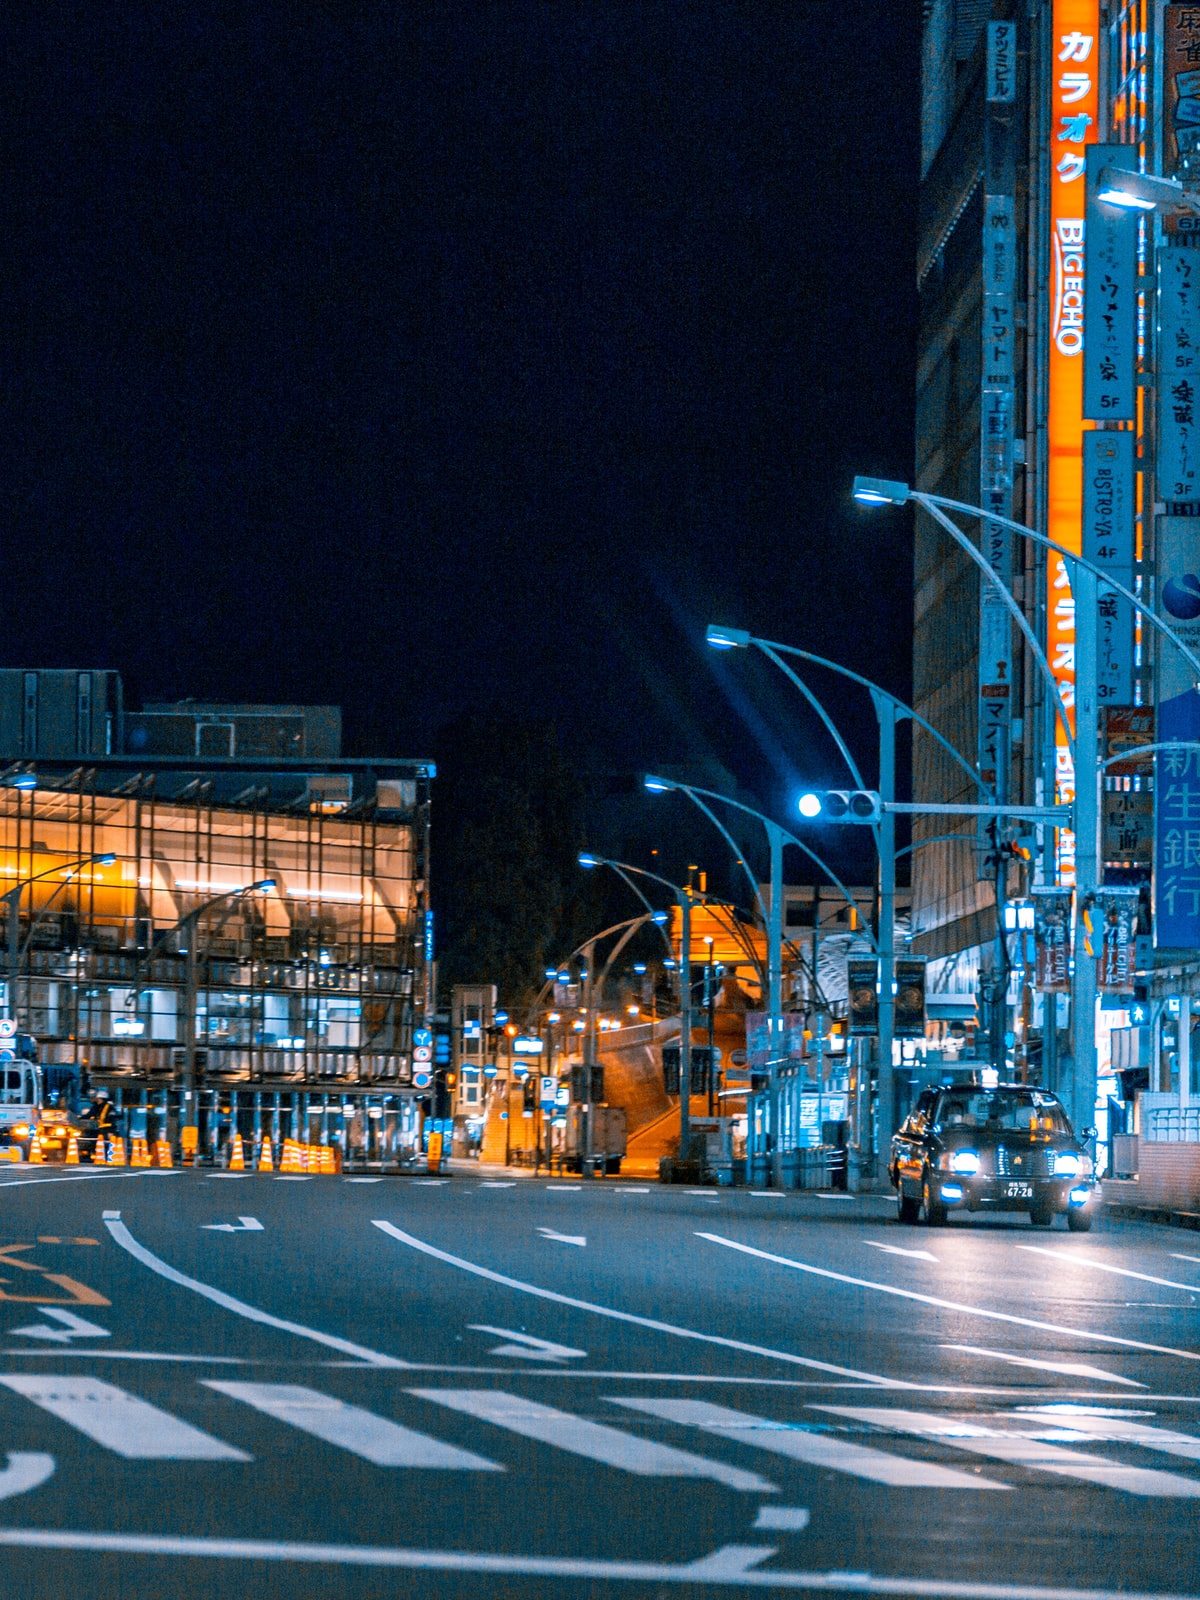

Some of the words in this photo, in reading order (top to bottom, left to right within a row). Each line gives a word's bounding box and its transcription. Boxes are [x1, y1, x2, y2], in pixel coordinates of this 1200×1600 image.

[1175, 355, 1194, 367] 5F
[1101, 396, 1120, 408] 5F
[1174, 482, 1193, 495] 3F
[1097, 545, 1118, 558] 4F
[1098, 684, 1117, 698] 3F
[543, 1079, 553, 1091] P
[1007, 1187, 1033, 1197] 67-28
